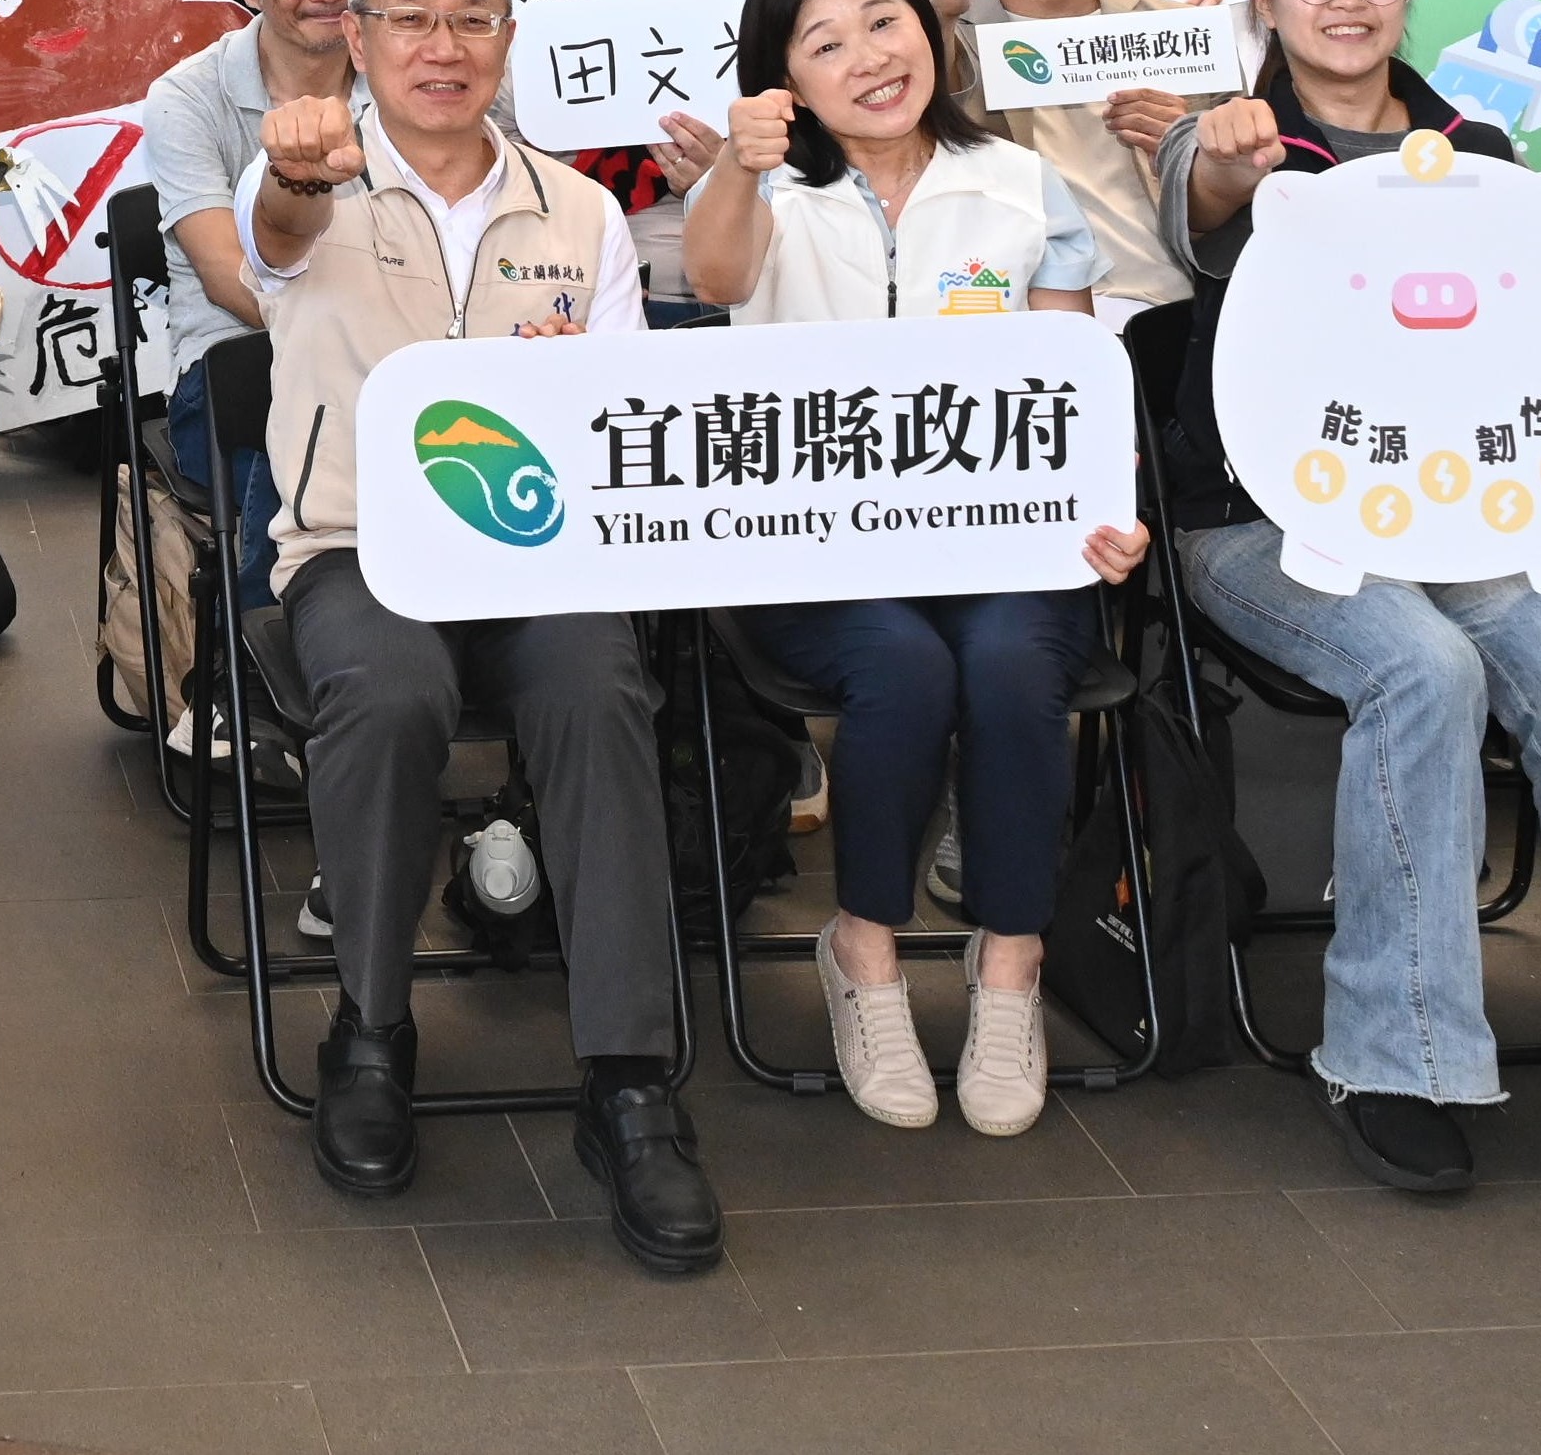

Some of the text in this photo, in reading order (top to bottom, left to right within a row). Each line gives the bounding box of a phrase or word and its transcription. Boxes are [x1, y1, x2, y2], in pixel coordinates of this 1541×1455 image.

[1057, 27, 1212, 67] 宜蘭縣政府
[1061, 62, 1216, 84] Yilan County Government
[519, 264, 585, 284] 宜蘭縣政府
[591, 378, 1080, 491] 宜蘭縣政府
[592, 493, 1080, 545] Yilan County Government
